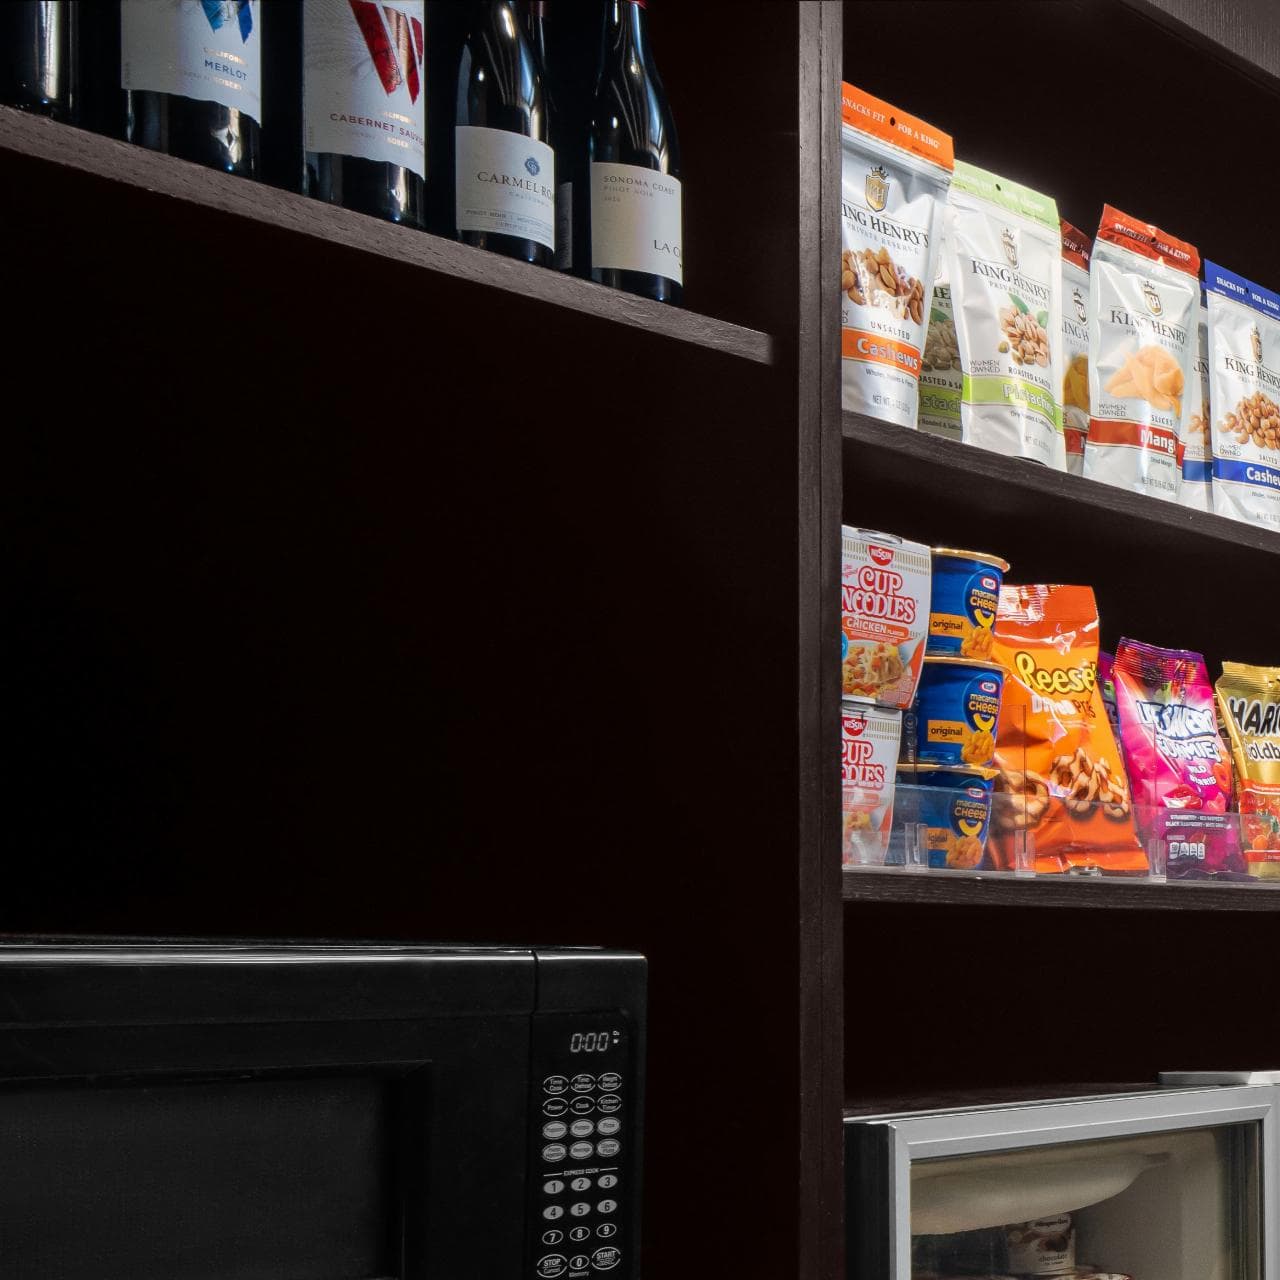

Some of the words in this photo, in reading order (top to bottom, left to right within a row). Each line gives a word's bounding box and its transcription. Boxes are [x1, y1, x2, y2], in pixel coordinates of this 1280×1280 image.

[204, 60, 247, 80] MERLOT
[329, 113, 395, 132] CABERNET
[872, 111, 886, 124] FIT
[897, 123, 913, 138] FOR
[920, 131, 939, 149] KING
[477, 171, 540, 193] CARMEL
[603, 176, 649, 188] SONOMA
[652, 183, 676, 195] COAST
[842, 203, 868, 226] ING
[972, 261, 1011, 283] KING
[870, 320, 911, 341] UNSALTED
[856, 338, 919, 371] Cashews
[1225, 357, 1254, 376] KING
[1151, 415, 1174, 427] SLICES
[858, 566, 903, 596] CUP
[842, 585, 916, 625] NOODLES
[846, 617, 887, 634] CHICKEN
[932, 619, 964, 631] original
[930, 726, 963, 737] original
[543, 1258, 561, 1267] STOP
[596, 1250, 616, 1260] START
